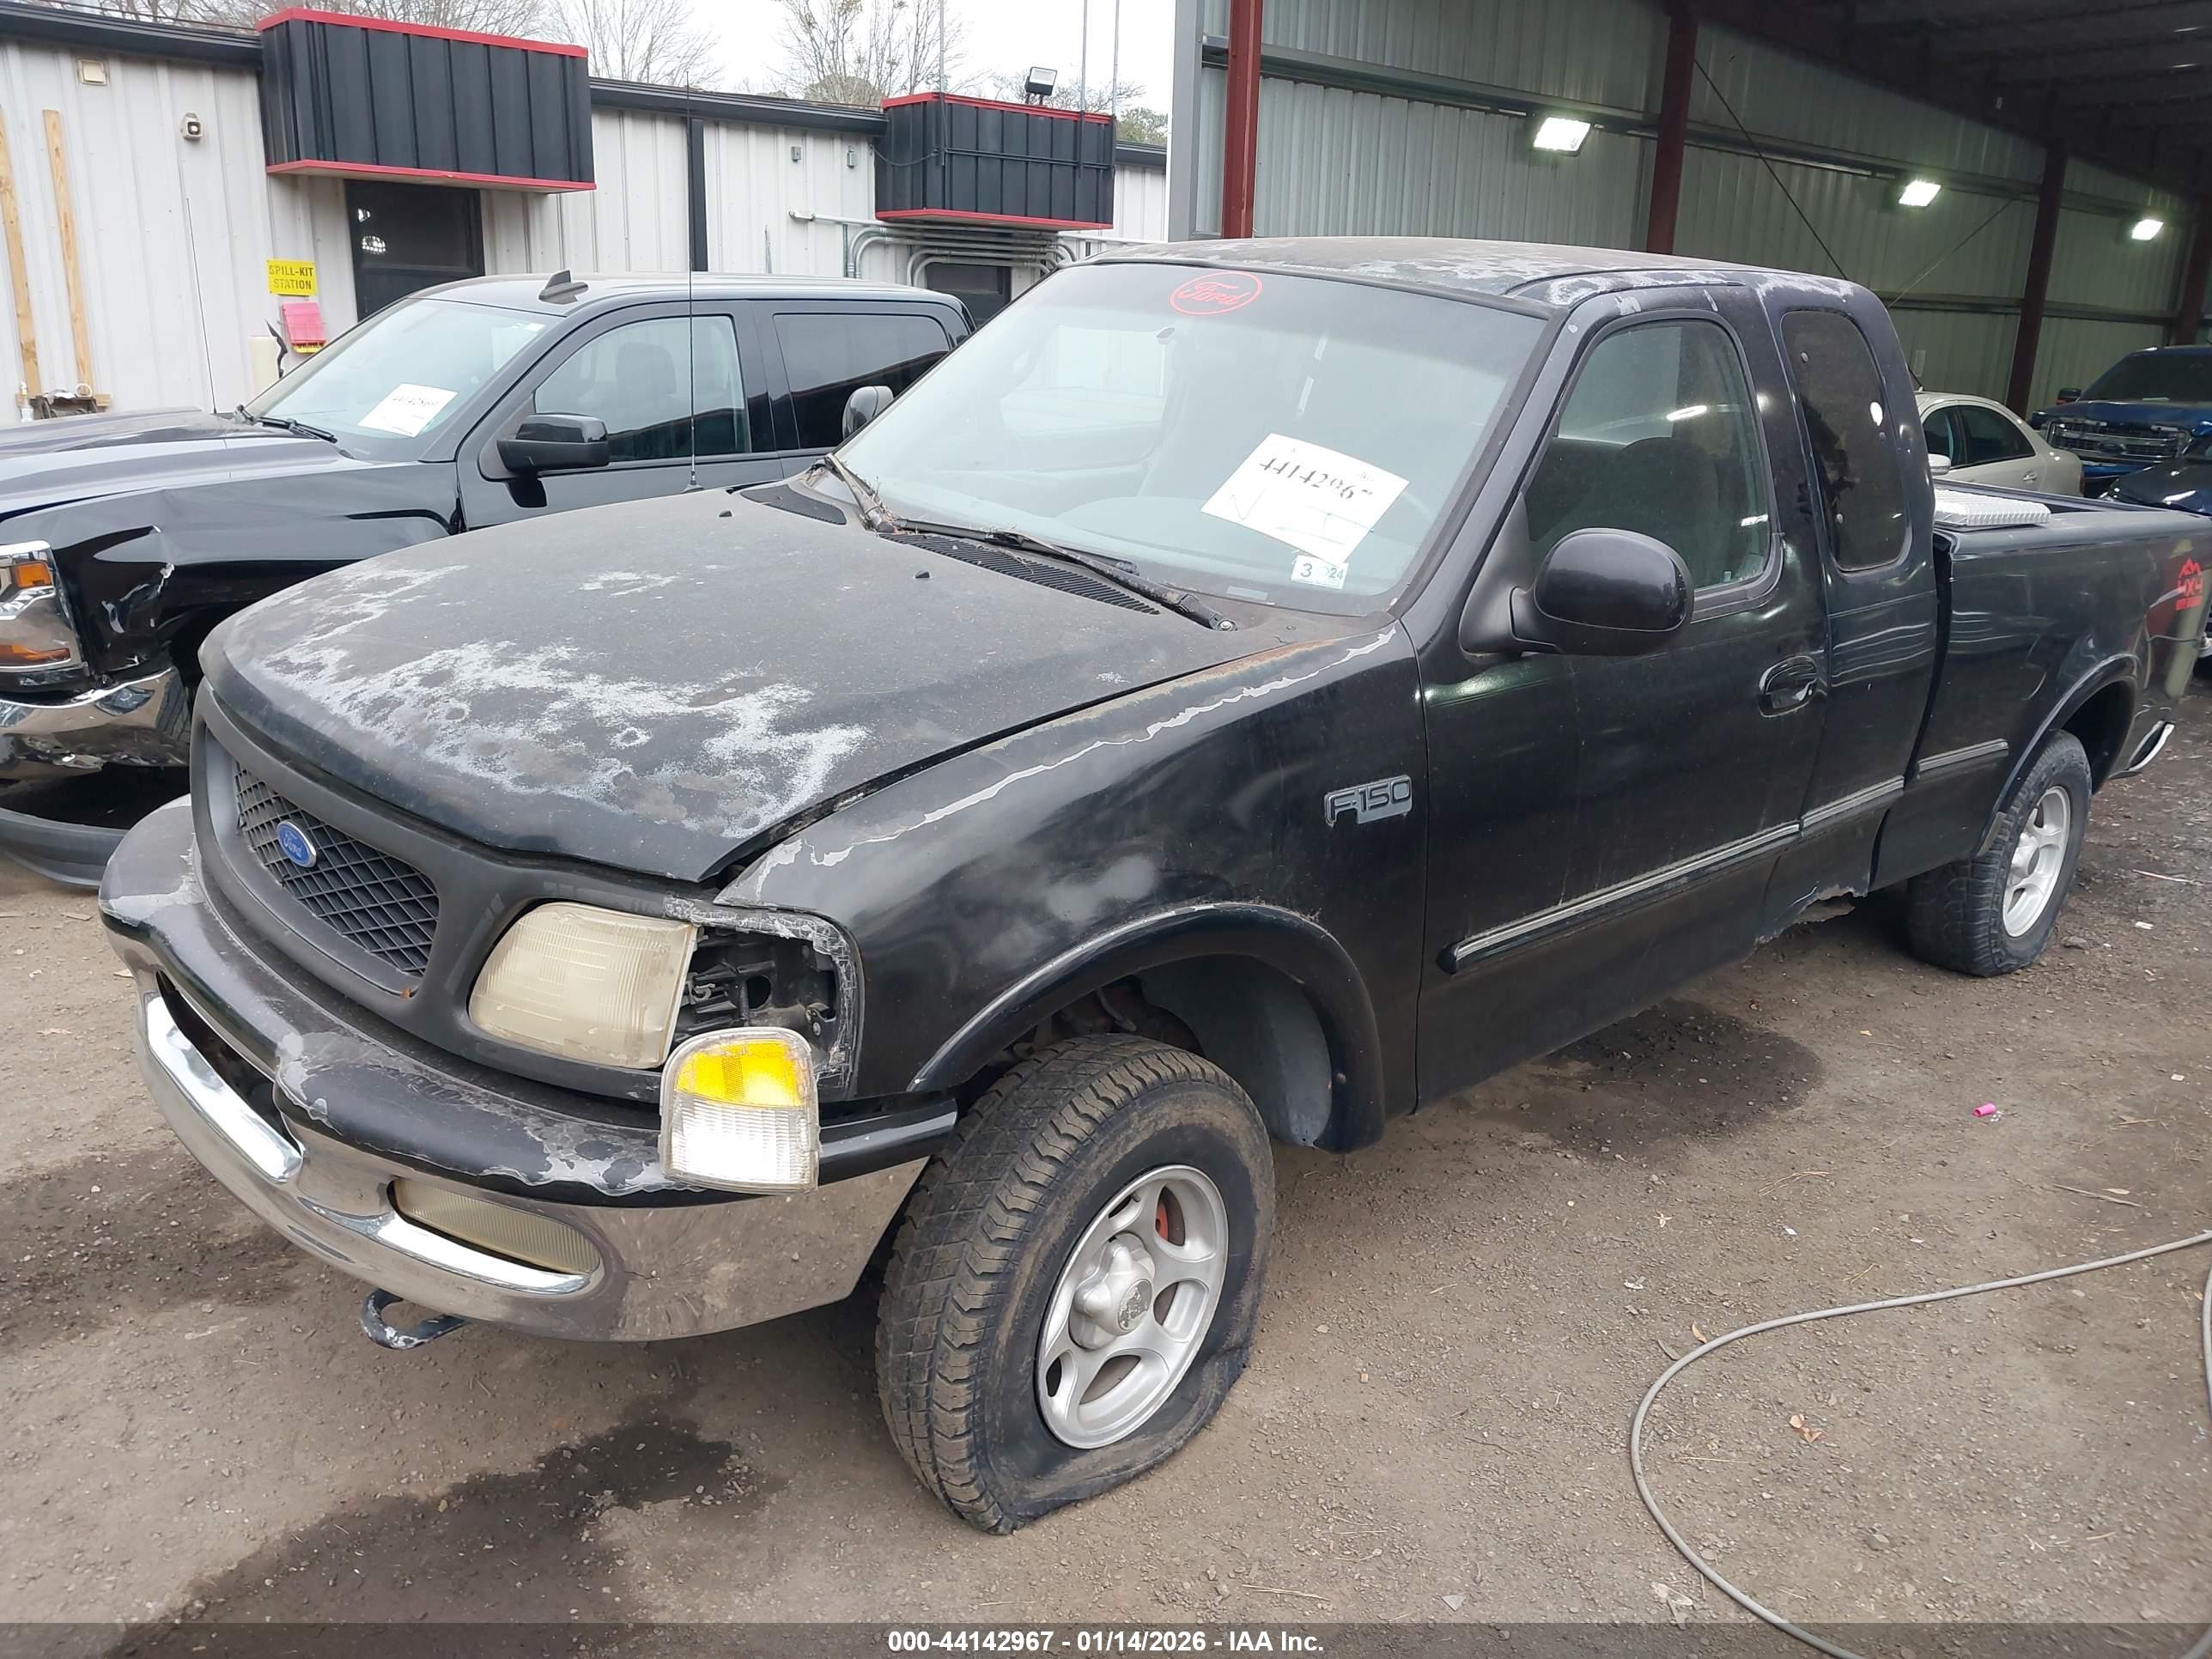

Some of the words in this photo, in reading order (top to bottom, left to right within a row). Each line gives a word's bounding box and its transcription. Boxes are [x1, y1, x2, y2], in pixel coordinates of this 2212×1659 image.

[269, 264, 314, 277] SPILL-KIT
[274, 279, 312, 290] STATION
[1259, 457, 1373, 500] 4414296
[1300, 562, 1313, 578] 3
